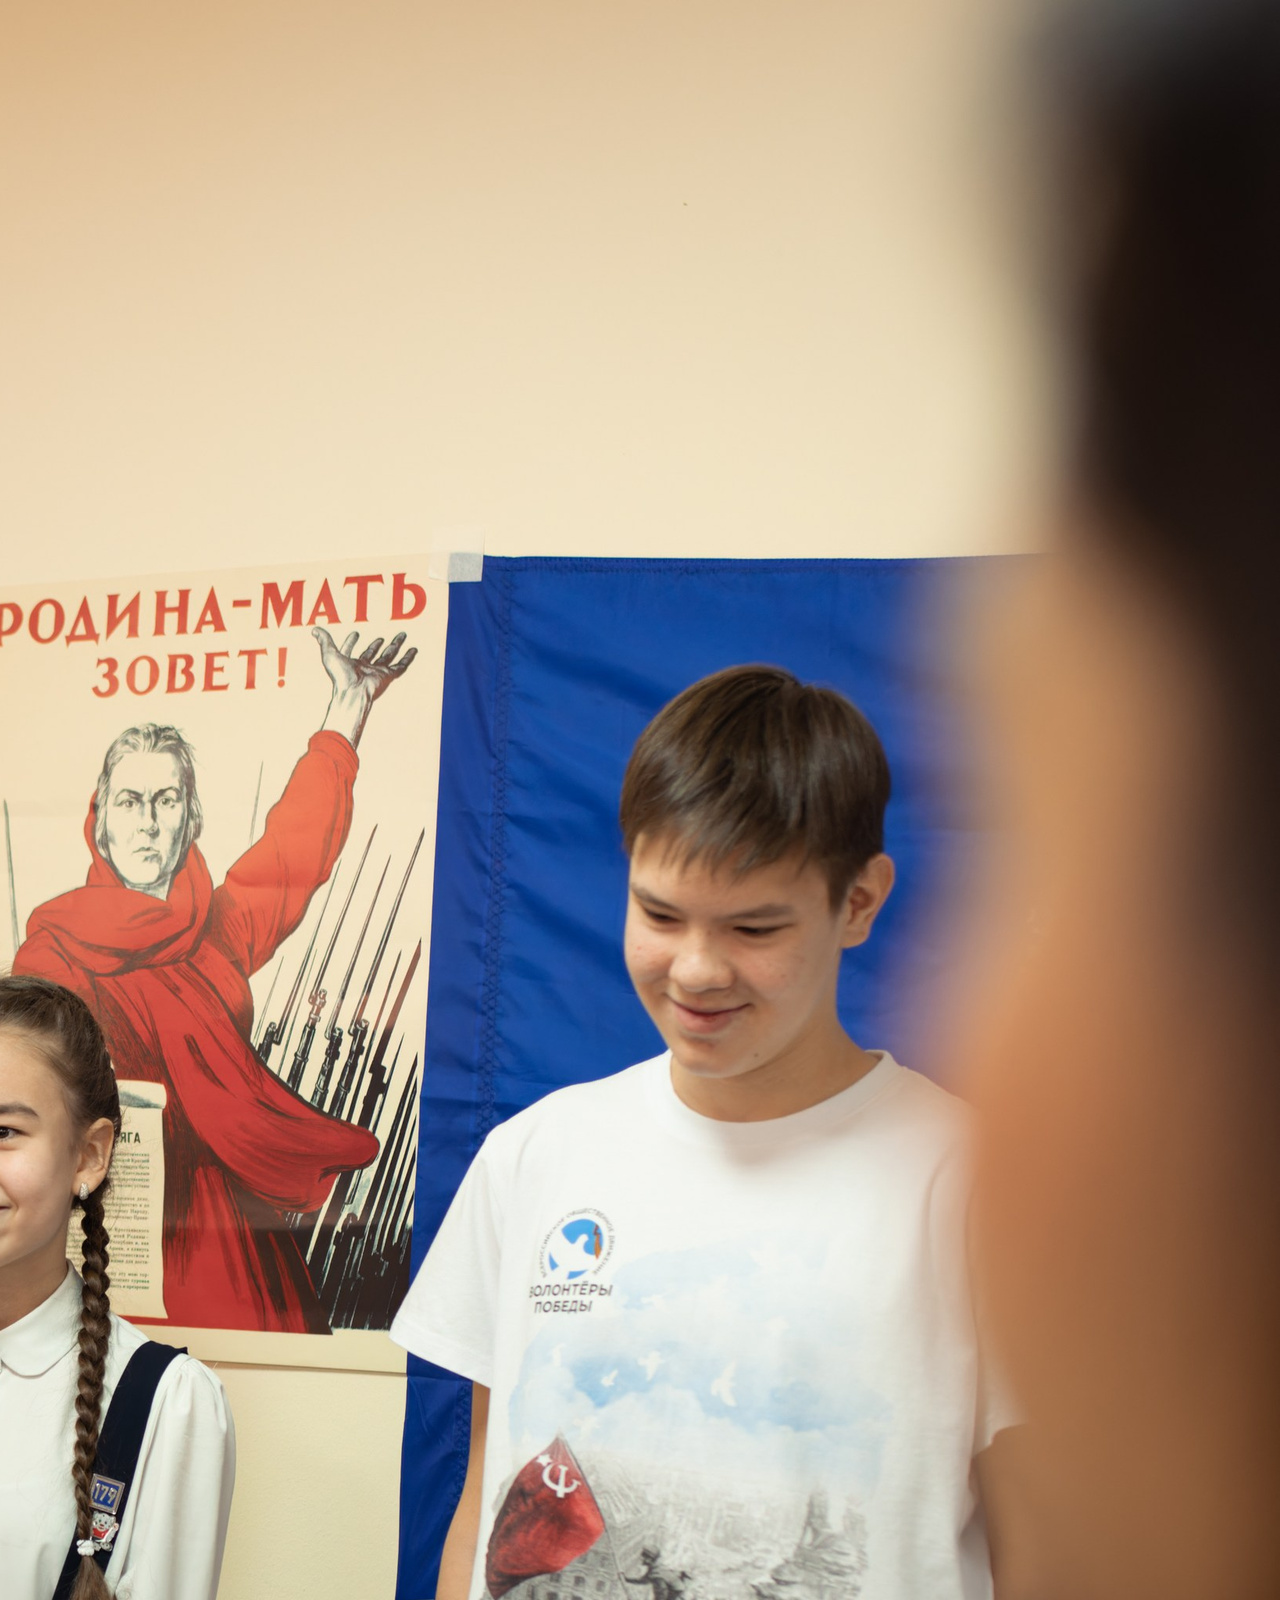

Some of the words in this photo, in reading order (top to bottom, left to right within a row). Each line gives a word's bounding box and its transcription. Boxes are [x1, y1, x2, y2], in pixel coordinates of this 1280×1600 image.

[91, 646, 288, 699] ЗОВЕТ!
[534, 1300, 593, 1314] ПОБЕДЫ
[94, 1483, 117, 1504] 179
